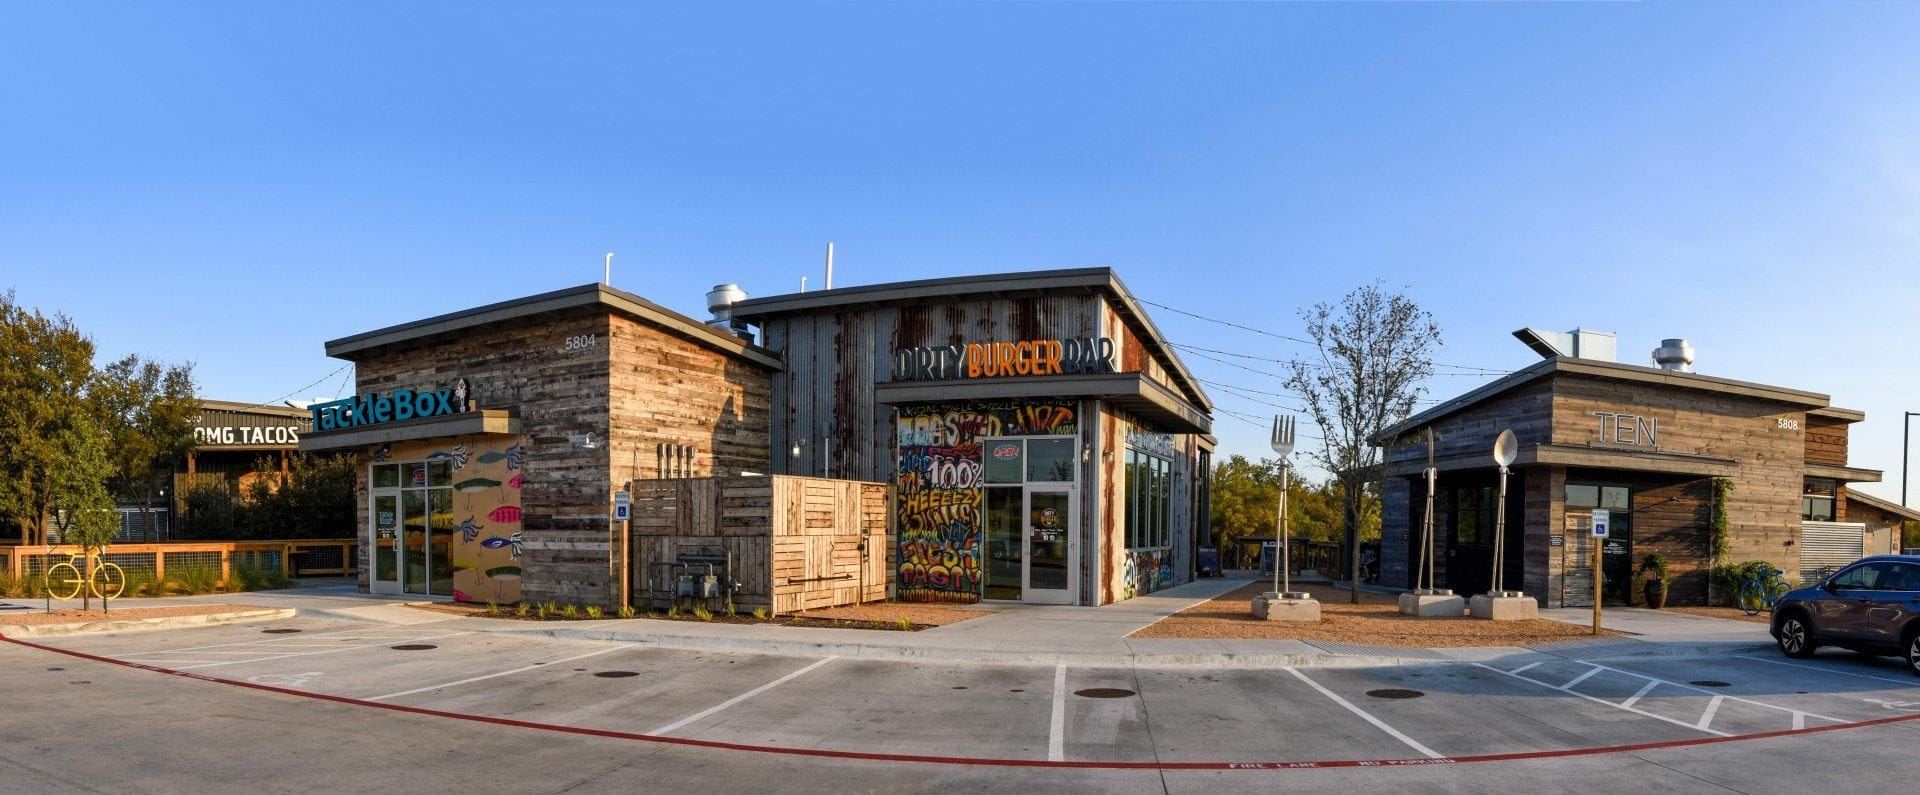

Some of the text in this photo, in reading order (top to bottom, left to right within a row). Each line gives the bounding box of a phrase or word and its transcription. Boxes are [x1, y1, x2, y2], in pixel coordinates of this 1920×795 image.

[565, 333, 596, 350] 5804
[896, 337, 1116, 380] DIRTY BURGER BAR
[1592, 411, 1658, 447] TEN
[1777, 418, 1799, 430] 5808
[194, 426, 299, 445] OMG TACOS
[993, 446, 1021, 458] OPEN
[926, 460, 984, 489] 100%
